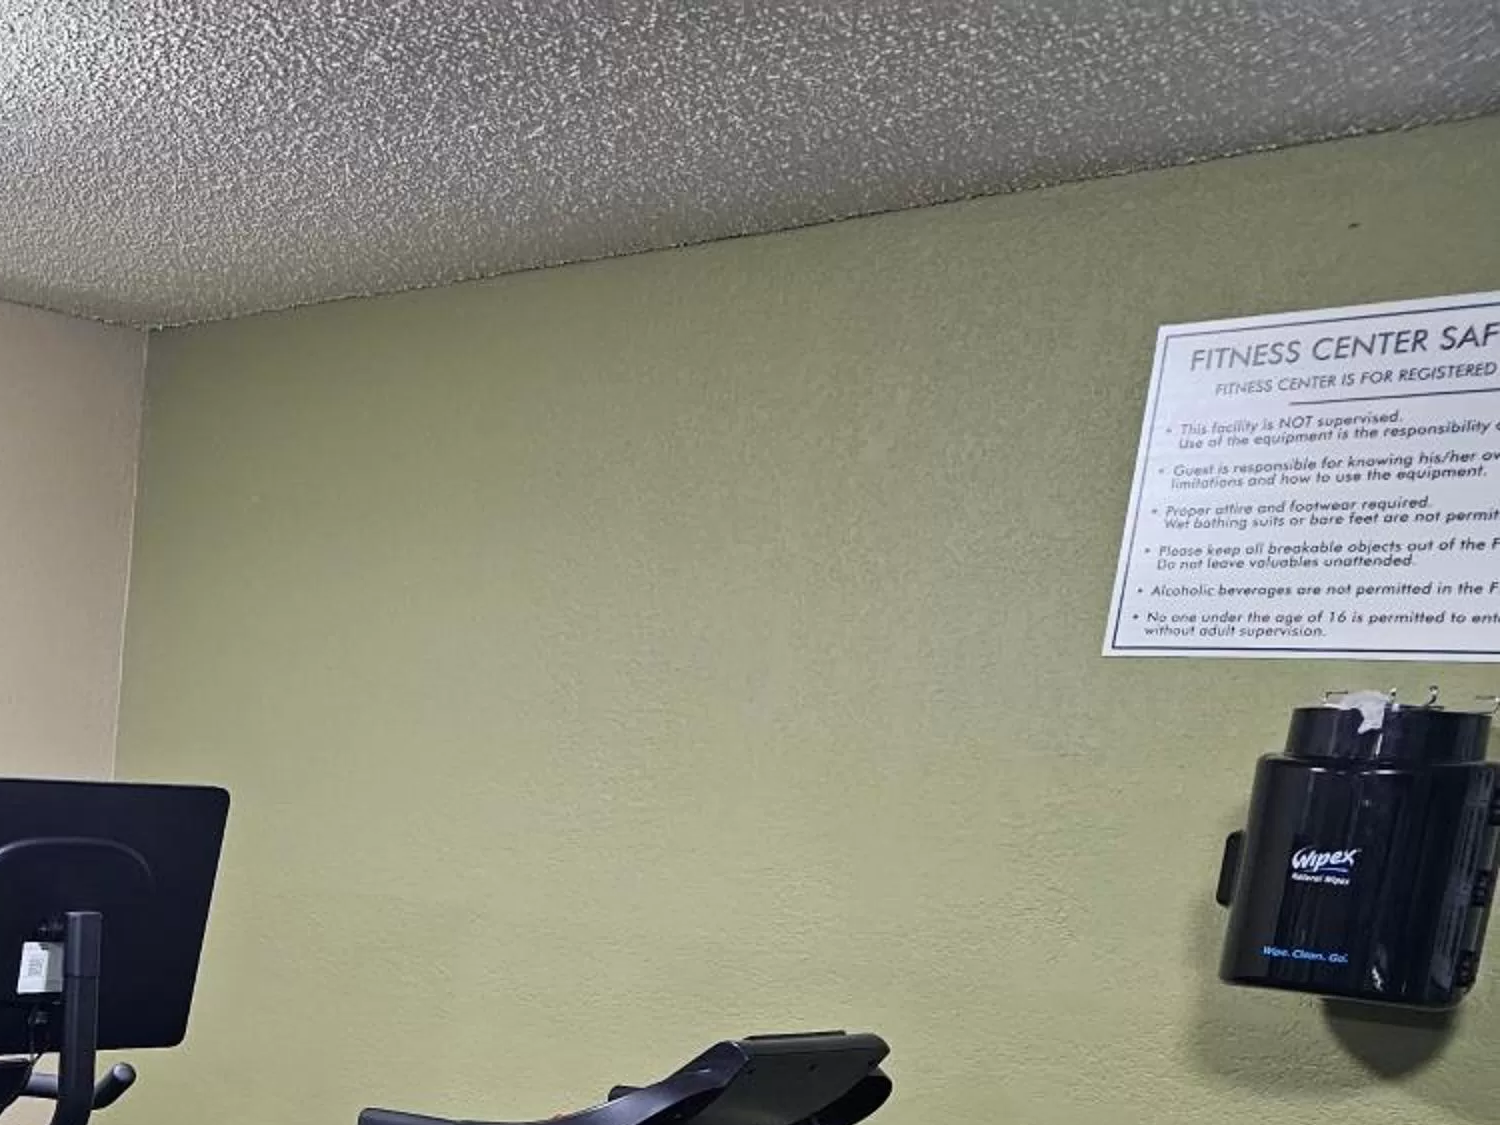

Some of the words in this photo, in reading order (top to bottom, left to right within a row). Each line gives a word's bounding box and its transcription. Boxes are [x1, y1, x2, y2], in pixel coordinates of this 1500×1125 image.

[1190, 341, 1300, 372] FITNESS
[1312, 329, 1429, 361] CENTER
[1440, 322, 1500, 350] SAF
[1215, 378, 1273, 396] FITNESS
[1278, 373, 1336, 391] CENTER
[1341, 371, 1355, 387] IS
[1360, 369, 1393, 385] FOR
[1398, 361, 1498, 382] REGISTERED
[1181, 423, 1206, 434] This
[1211, 419, 1258, 435] facility
[1263, 417, 1273, 430] is
[1279, 415, 1313, 429] NOT
[1317, 409, 1402, 428] supervised.
[1179, 438, 1203, 449] Use
[1207, 436, 1223, 447] of
[1227, 435, 1249, 446] the
[1254, 430, 1333, 447] equipment
[1338, 428, 1348, 440] is
[1355, 426, 1379, 439] the
[1383, 419, 1491, 438] responsibility
[1173, 463, 1214, 477] Guest
[1218, 463, 1229, 475] is
[1233, 458, 1317, 474] responsible
[1321, 456, 1343, 468] for
[1347, 453, 1413, 468] knowing
[1419, 450, 1476, 464] his/her
[1171, 477, 1243, 489] limitations
[1248, 473, 1277, 487] and
[1280, 473, 1312, 485] how
[1316, 471, 1331, 483] to
[1335, 472, 1362, 483] use
[1367, 468, 1391, 480] the
[1397, 465, 1487, 481] equipment.
[1165, 505, 1211, 518] Proper
[1215, 502, 1253, 515] attire
[1257, 500, 1286, 513] and
[1288, 498, 1356, 513] footwear
[1165, 517, 1191, 529] Wet
[1194, 516, 1247, 531] bathing
[1252, 514, 1286, 527] suits
[1290, 515, 1305, 526] or
[1309, 511, 1345, 525] bare
[1350, 511, 1379, 525] feet
[1383, 513, 1410, 523] are
[1415, 511, 1441, 523] not
[1160, 545, 1203, 557] Please
[1207, 543, 1241, 557] keep
[1245, 541, 1264, 555] all
[1268, 540, 1343, 555] breakable
[1347, 540, 1402, 555] objects
[1407, 540, 1434, 551] out
[1438, 537, 1456, 551] of
[1460, 536, 1486, 550] the
[1157, 559, 1176, 570] Do
[1180, 559, 1203, 570] not
[1207, 557, 1246, 569] leave
[1249, 556, 1319, 569] valuables
[1150, 584, 1215, 597] Alcoholic
[1218, 584, 1292, 598] beverages
[1296, 585, 1321, 595] are
[1325, 583, 1351, 595] not
[1355, 581, 1433, 598] permitted
[1437, 580, 1453, 595] in
[1457, 581, 1483, 595] the
[1147, 611, 1167, 623] No
[1171, 613, 1197, 623] one
[1201, 609, 1243, 623] under
[1247, 611, 1271, 623] the
[1275, 613, 1303, 626] age
[1307, 610, 1324, 623] of
[1329, 611, 1347, 623] 16
[1352, 611, 1363, 623] is
[1367, 609, 1446, 626] permitted
[1450, 611, 1467, 623] to
[1143, 625, 1195, 637] without
[1199, 624, 1236, 637] adult
[1239, 627, 1327, 639] supervision.
[1291, 847, 1358, 873] Wipex
